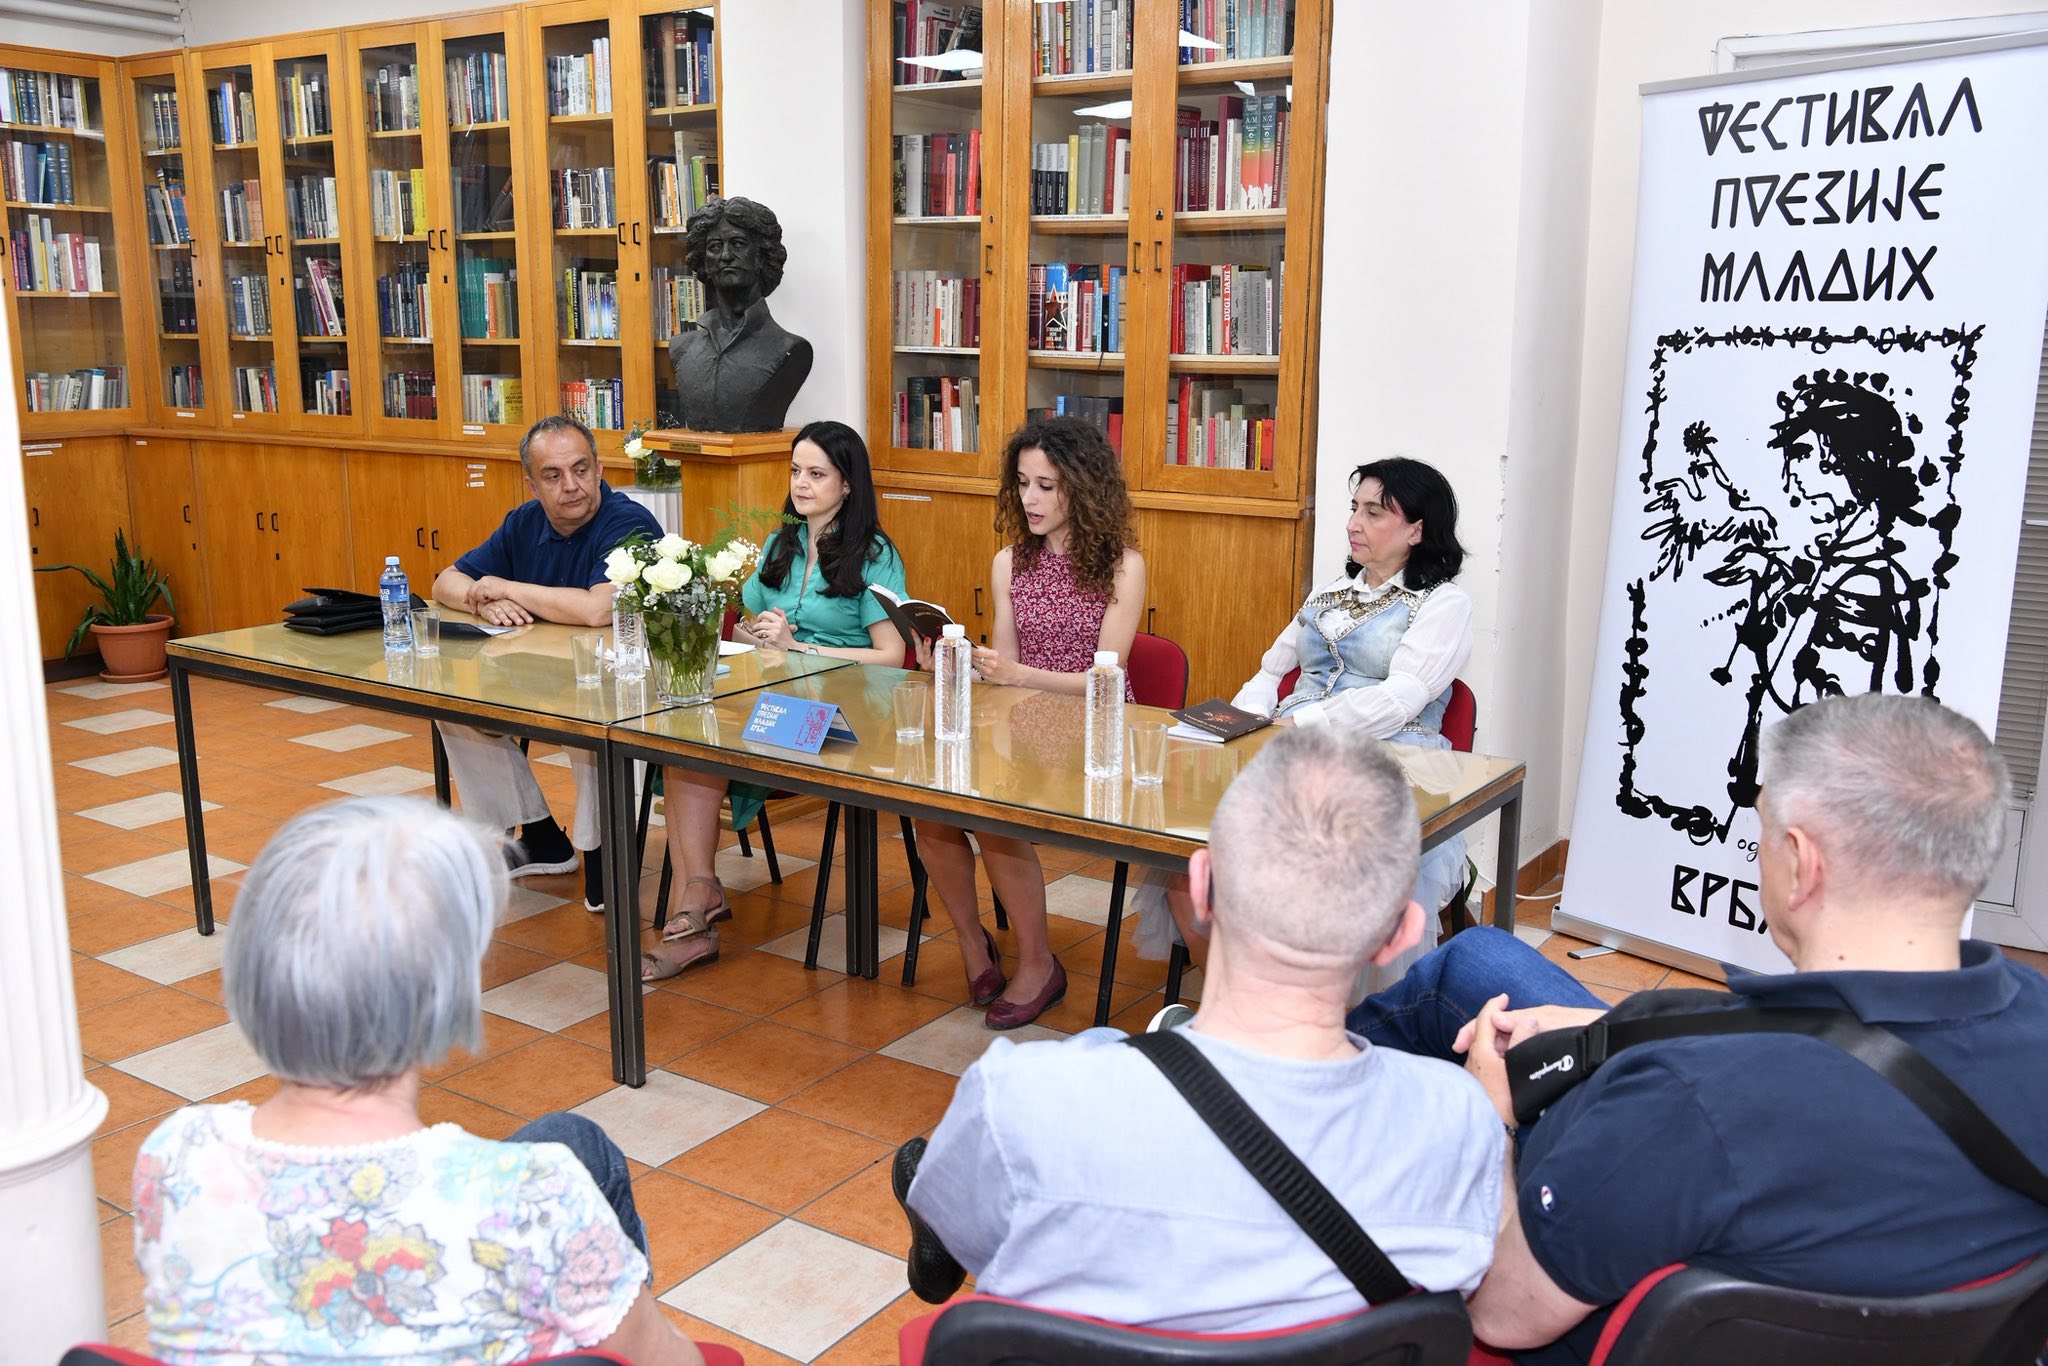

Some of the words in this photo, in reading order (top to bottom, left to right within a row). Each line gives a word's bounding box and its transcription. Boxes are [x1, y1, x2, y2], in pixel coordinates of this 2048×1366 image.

[1699, 78, 1982, 156] ФЕСТИВАЛ
[1712, 164, 1945, 229] ПОЕЗИЈЕ
[1701, 246, 1937, 302] МЛАДИХ
[1671, 864, 1768, 935] ВРБ
